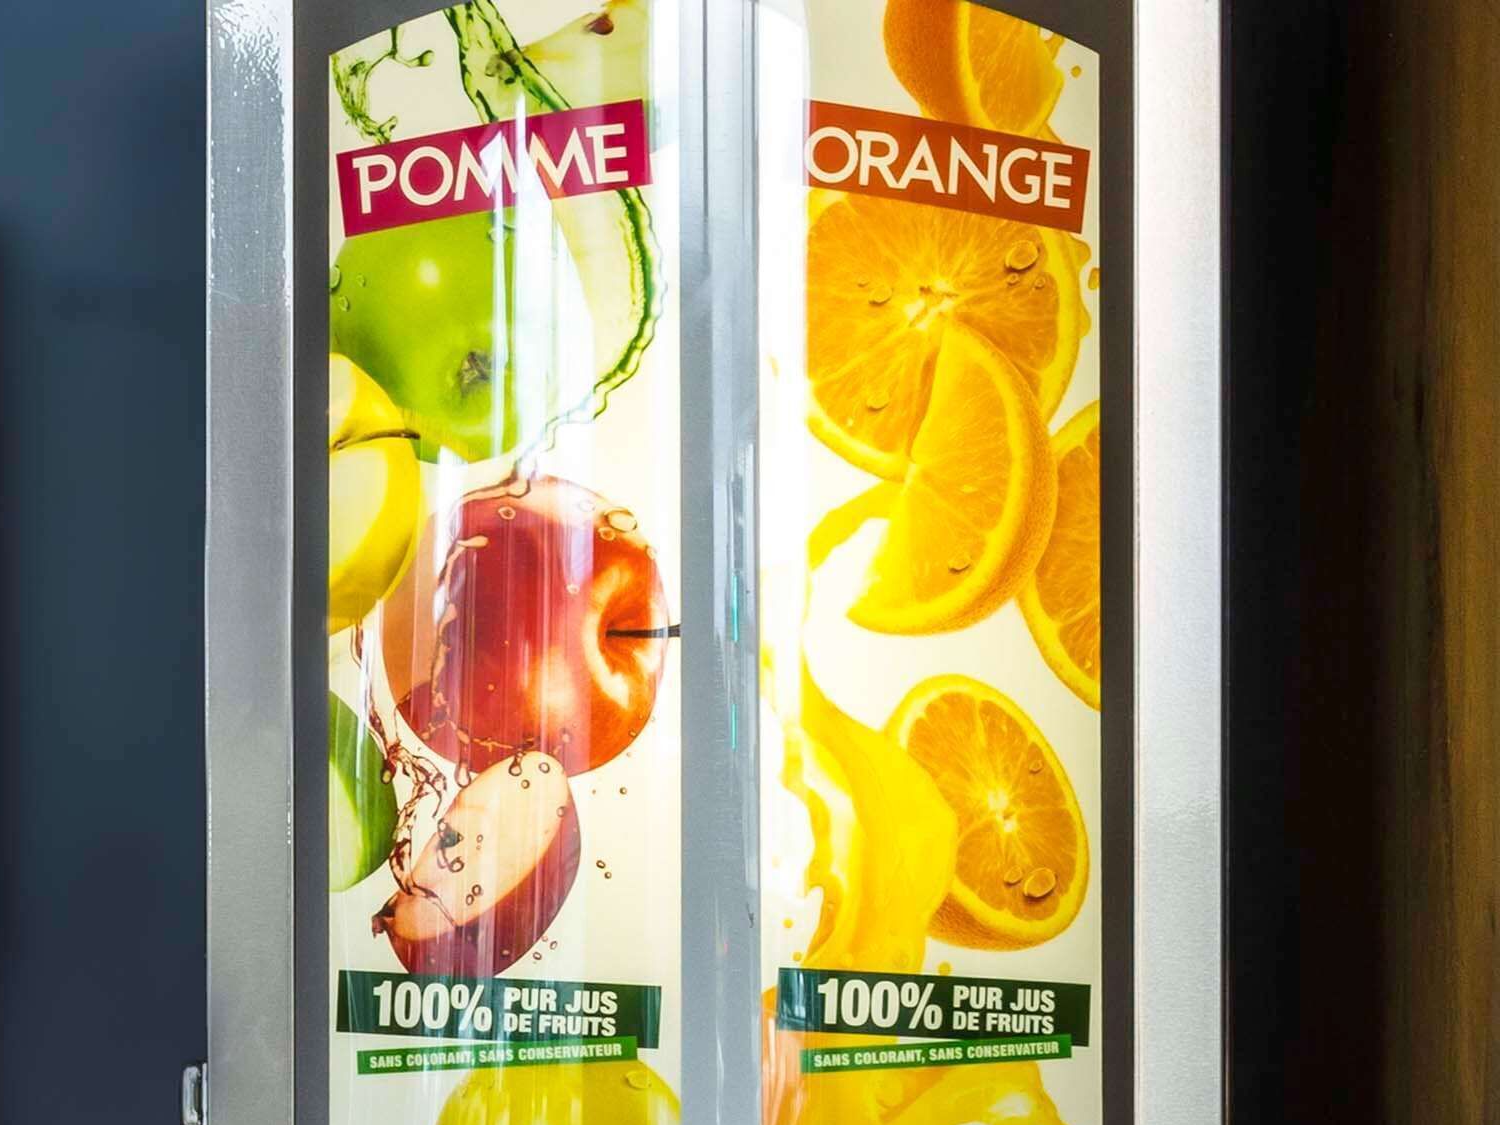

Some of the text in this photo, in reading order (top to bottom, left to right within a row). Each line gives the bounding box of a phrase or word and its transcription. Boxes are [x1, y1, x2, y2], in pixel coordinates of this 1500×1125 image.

[352, 122, 629, 215] POMME
[803, 126, 1074, 209] ORANGE
[373, 980, 493, 1033] 100%
[504, 986, 618, 1015] PUR JUS
[817, 977, 943, 1031] 100%
[952, 984, 1056, 1013] PUR JUS
[504, 1014, 618, 1037] DE FRUITS
[952, 1012, 1055, 1035] DE FRUITS
[369, 1043, 623, 1070] SANS COLORANT, SANS CONSERVATEUR
[813, 1040, 1060, 1068] SANS COLORANT, SANS CONSERVATEUR
